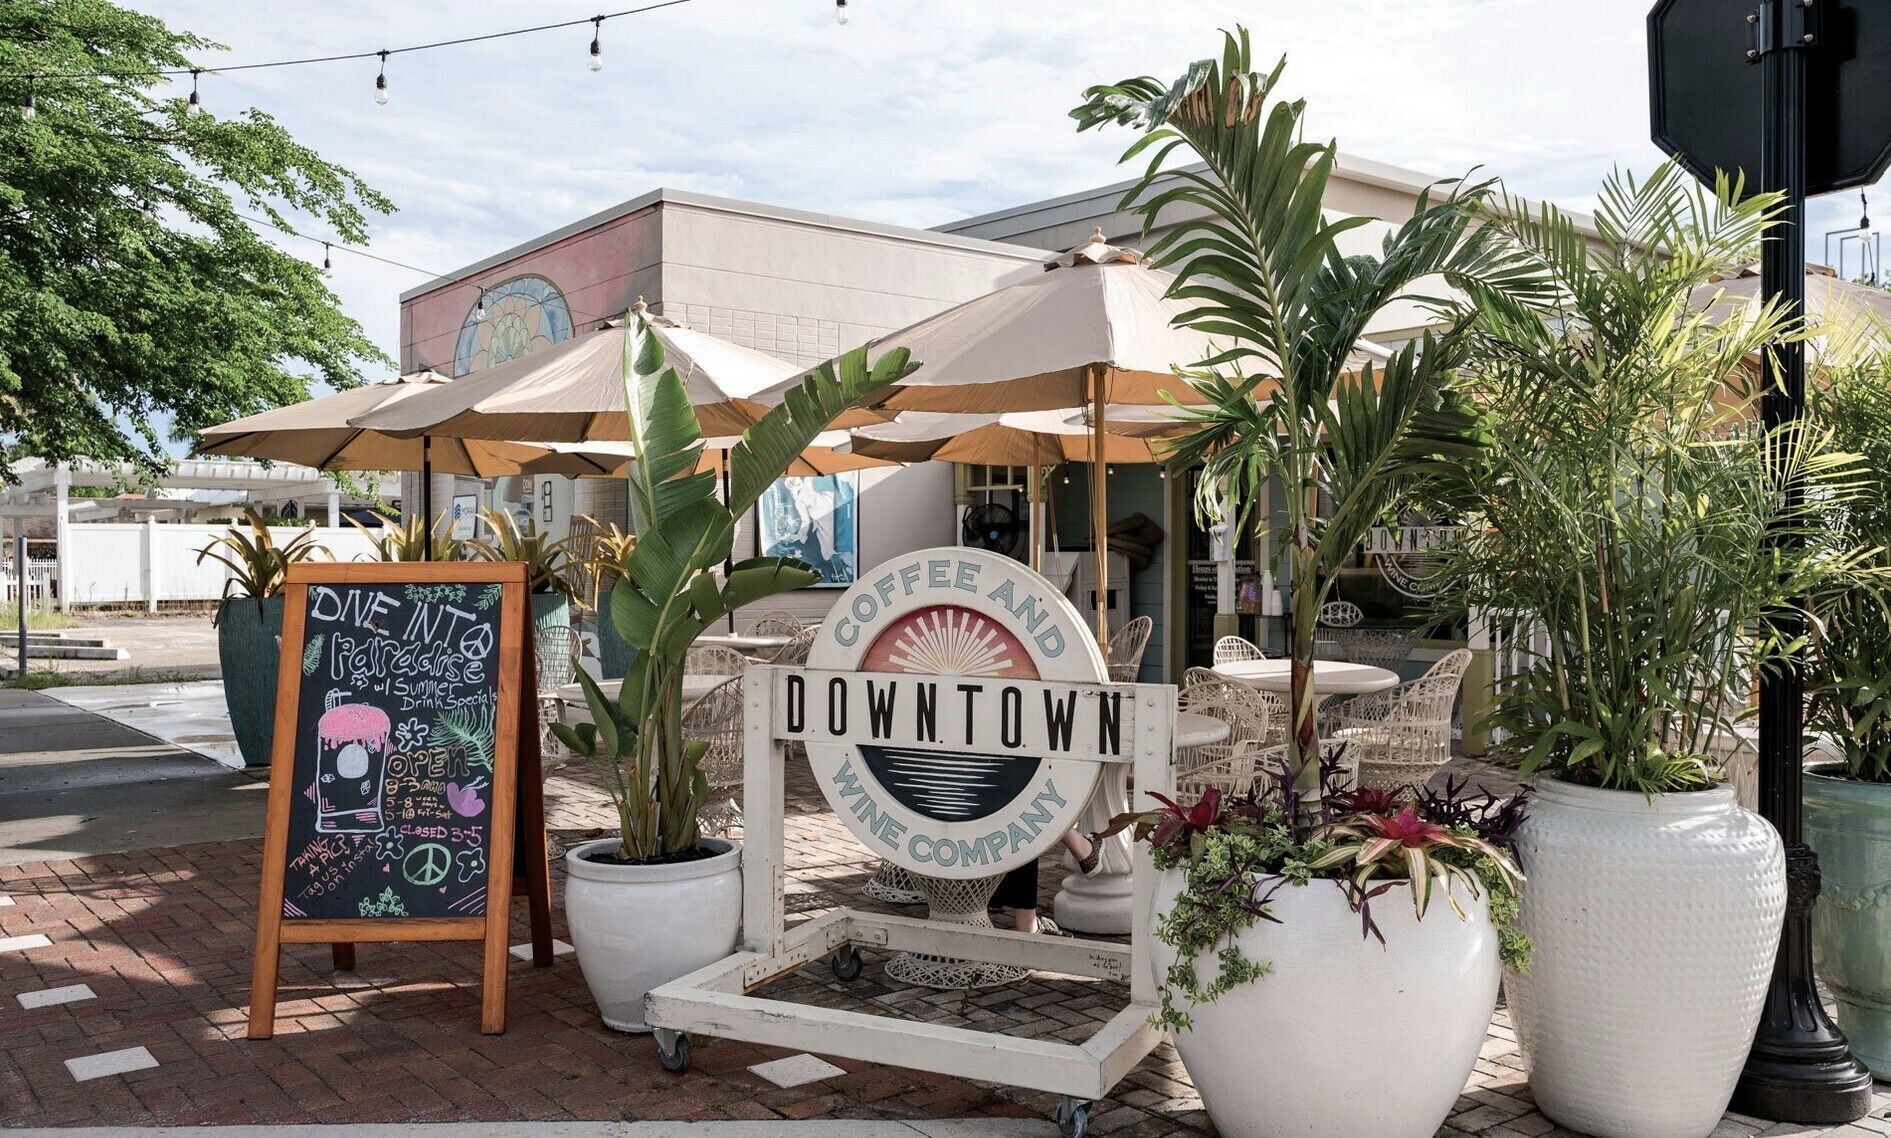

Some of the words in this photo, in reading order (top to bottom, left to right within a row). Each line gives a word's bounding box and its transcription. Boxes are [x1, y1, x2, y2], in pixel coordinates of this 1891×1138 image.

[1384, 558, 1409, 588] WINE
[311, 586, 400, 636] DIVE
[834, 559, 981, 648] COFFEE
[987, 578, 1066, 659] AND
[330, 632, 486, 684] Paradise
[374, 678, 391, 695] w/
[393, 678, 464, 697] Summer
[400, 696, 445, 711] Drink
[444, 686, 498, 710] Specials
[786, 673, 1121, 756] DOWNTOWN
[832, 761, 908, 851] WINE
[908, 778, 1067, 868] COMPANY
[400, 824, 448, 838] CLOSED
[289, 835, 329, 871] TAKING
[308, 863, 320, 877] A
[327, 874, 345, 891] on
[297, 881, 325, 899] Tag
